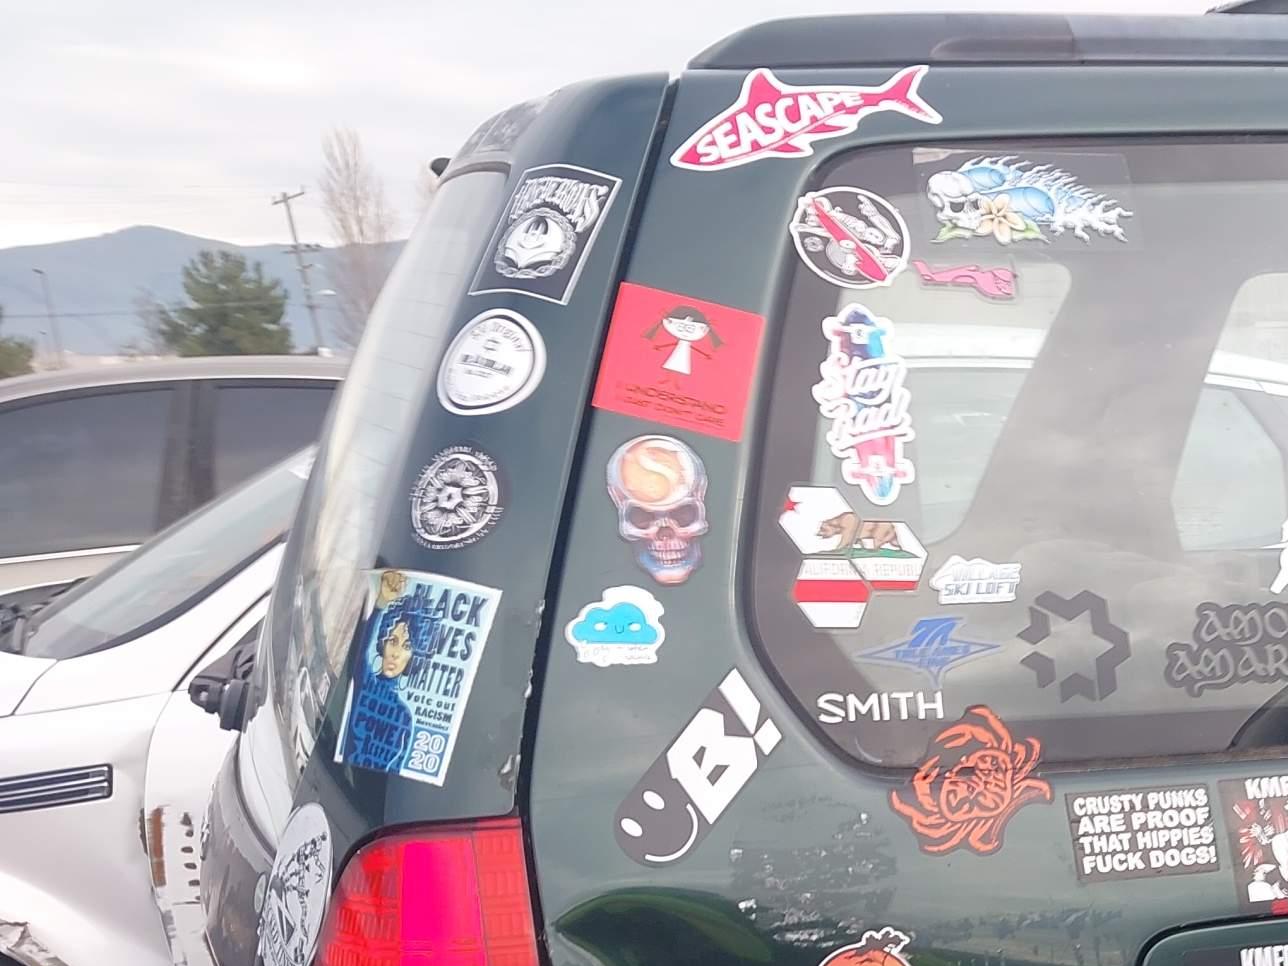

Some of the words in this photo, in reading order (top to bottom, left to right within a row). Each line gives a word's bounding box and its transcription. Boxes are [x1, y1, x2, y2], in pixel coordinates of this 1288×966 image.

[697, 92, 864, 162] SEASCAPE
[824, 352, 902, 405] Stay
[625, 384, 729, 414] UNDERSTAND
[824, 391, 911, 446] Rad
[952, 564, 1021, 580] VILLAGE
[944, 582, 970, 597] SKI
[975, 581, 1017, 595] LOFT
[410, 584, 489, 627] BLACK
[414, 619, 477, 661] LIVES
[407, 656, 465, 699] MATTER
[406, 691, 433, 706] Vote
[436, 700, 456, 711] out
[414, 705, 453, 724] RACISM
[816, 690, 945, 724] SMITH
[413, 730, 446, 754] 20
[407, 750, 441, 774] 20
[1073, 793, 1143, 816] CRUSTY
[1149, 788, 1208, 810] PUNKS
[1078, 814, 1126, 836] ARE
[1132, 807, 1209, 830] PROOF
[1079, 835, 1133, 855] THAT
[1137, 825, 1215, 850] HIPPIES
[1082, 852, 1146, 875] FUCK
[1150, 846, 1217, 870] DOGS!
